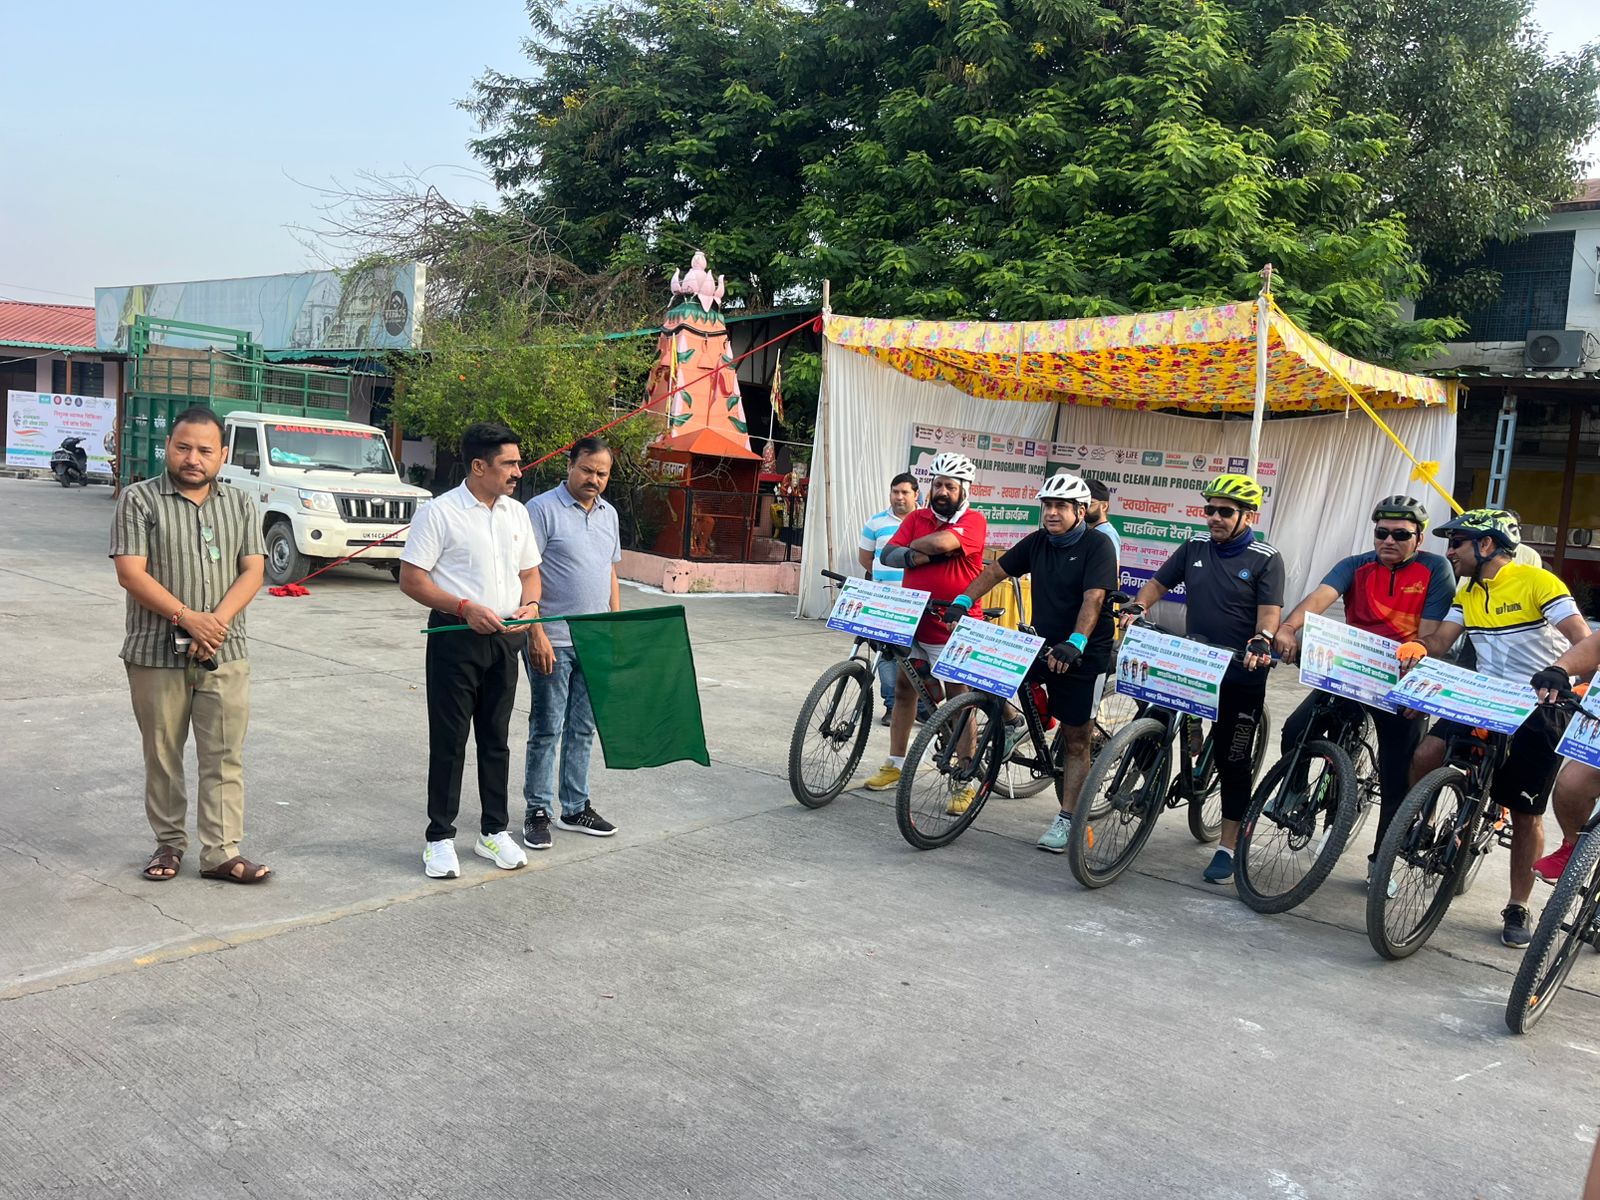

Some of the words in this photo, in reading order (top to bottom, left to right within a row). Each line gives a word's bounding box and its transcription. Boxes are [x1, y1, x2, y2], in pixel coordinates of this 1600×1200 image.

[275, 424, 373, 440] AMBULANCE
[994, 461, 1027, 473] PROGRAMME
[1080, 469, 1120, 483] NATIONAL
[1123, 473, 1150, 485] CLEAN
[1152, 475, 1167, 487] AIR
[991, 506, 1004, 520] रैली
[1005, 507, 1029, 520] कार्यक्रम
[1123, 522, 1168, 538] साइकिल
[1170, 524, 1192, 539] रैली
